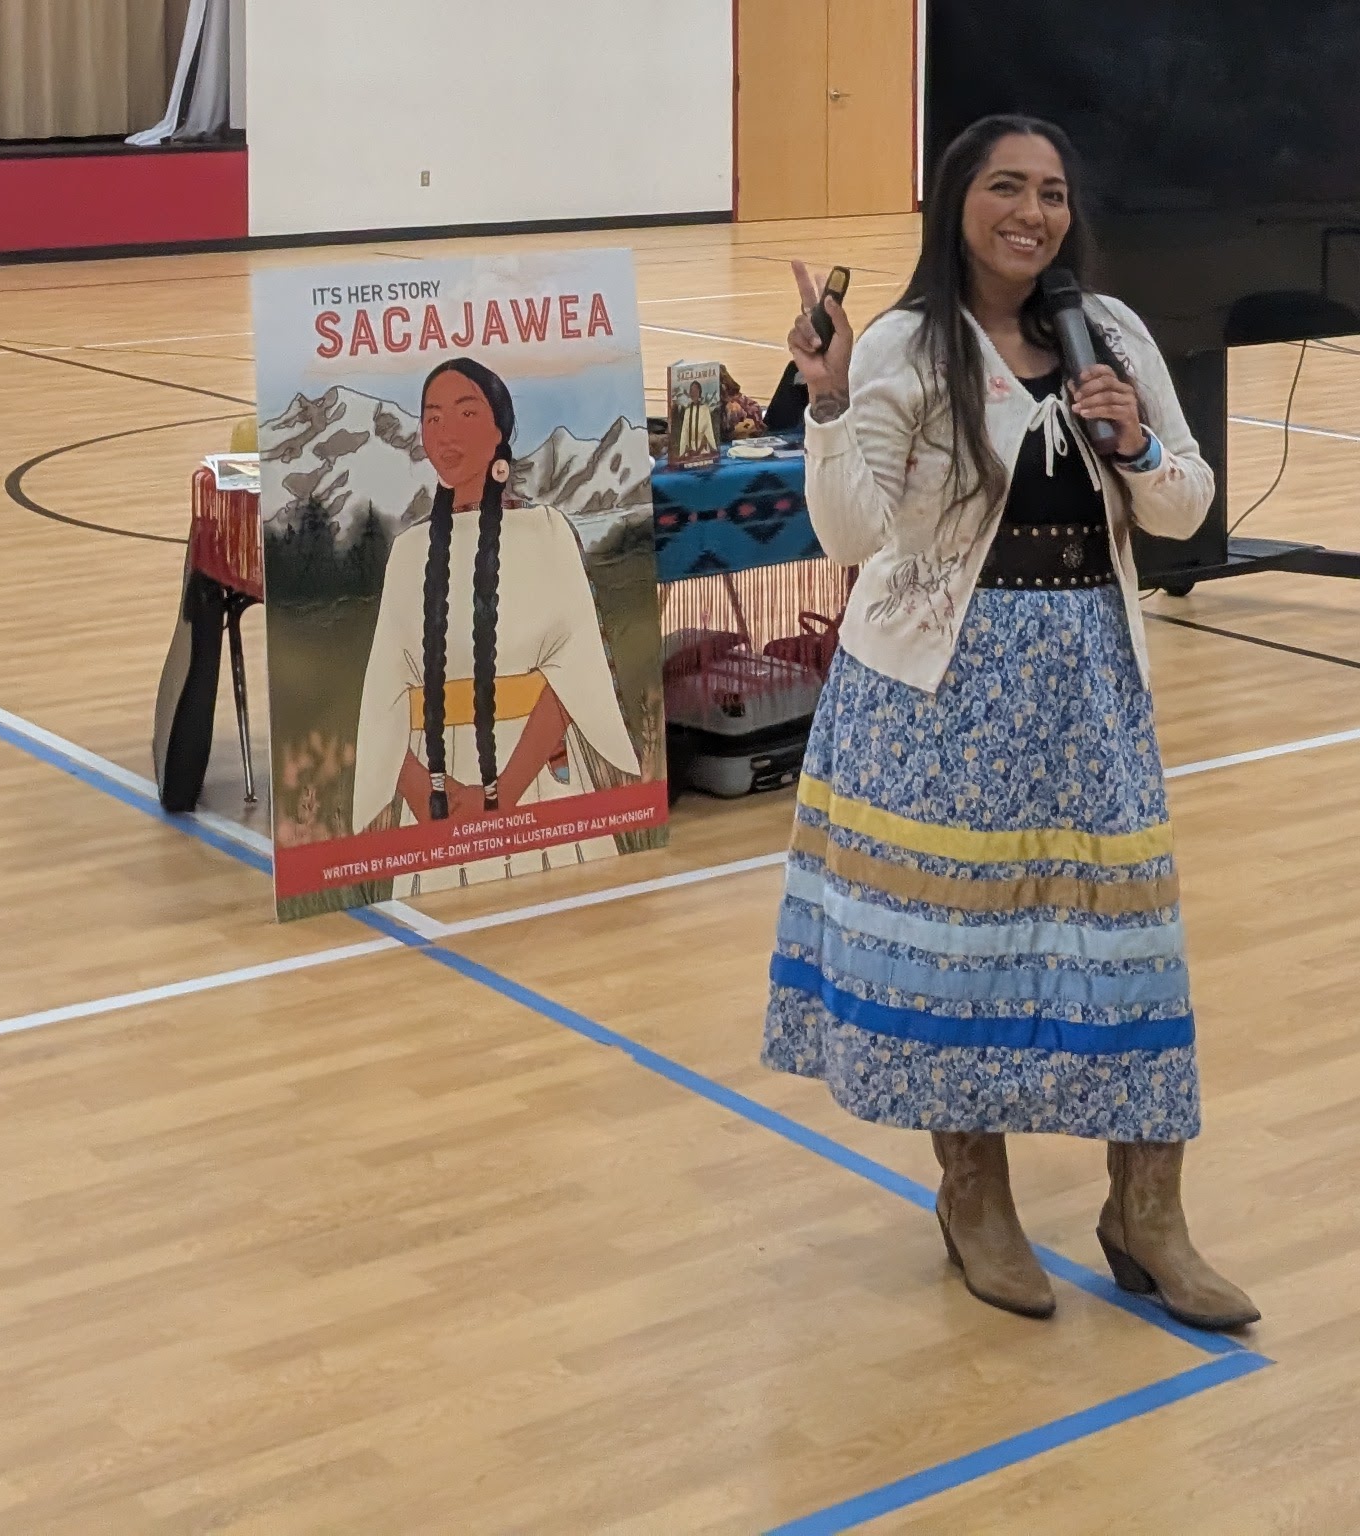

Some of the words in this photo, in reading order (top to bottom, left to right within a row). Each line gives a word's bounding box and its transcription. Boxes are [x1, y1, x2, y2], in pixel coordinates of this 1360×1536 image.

[312, 286, 343, 306] IT'S
[347, 284, 384, 305] HER
[387, 280, 441, 302] STORY
[314, 293, 614, 360] SACAJAWEA
[452, 826, 461, 837] A
[461, 817, 504, 835] GRAPHIC
[505, 812, 538, 828] NOVEL
[322, 861, 369, 880] WRITTEN
[371, 858, 384, 872] BY
[385, 850, 428, 869] RANDY'L
[430, 842, 471, 860] HE-DOW
[473, 836, 504, 852] TETON
[513, 822, 575, 845] ILLUSTRATED
[577, 819, 590, 833] BY
[590, 816, 608, 831] ALY
